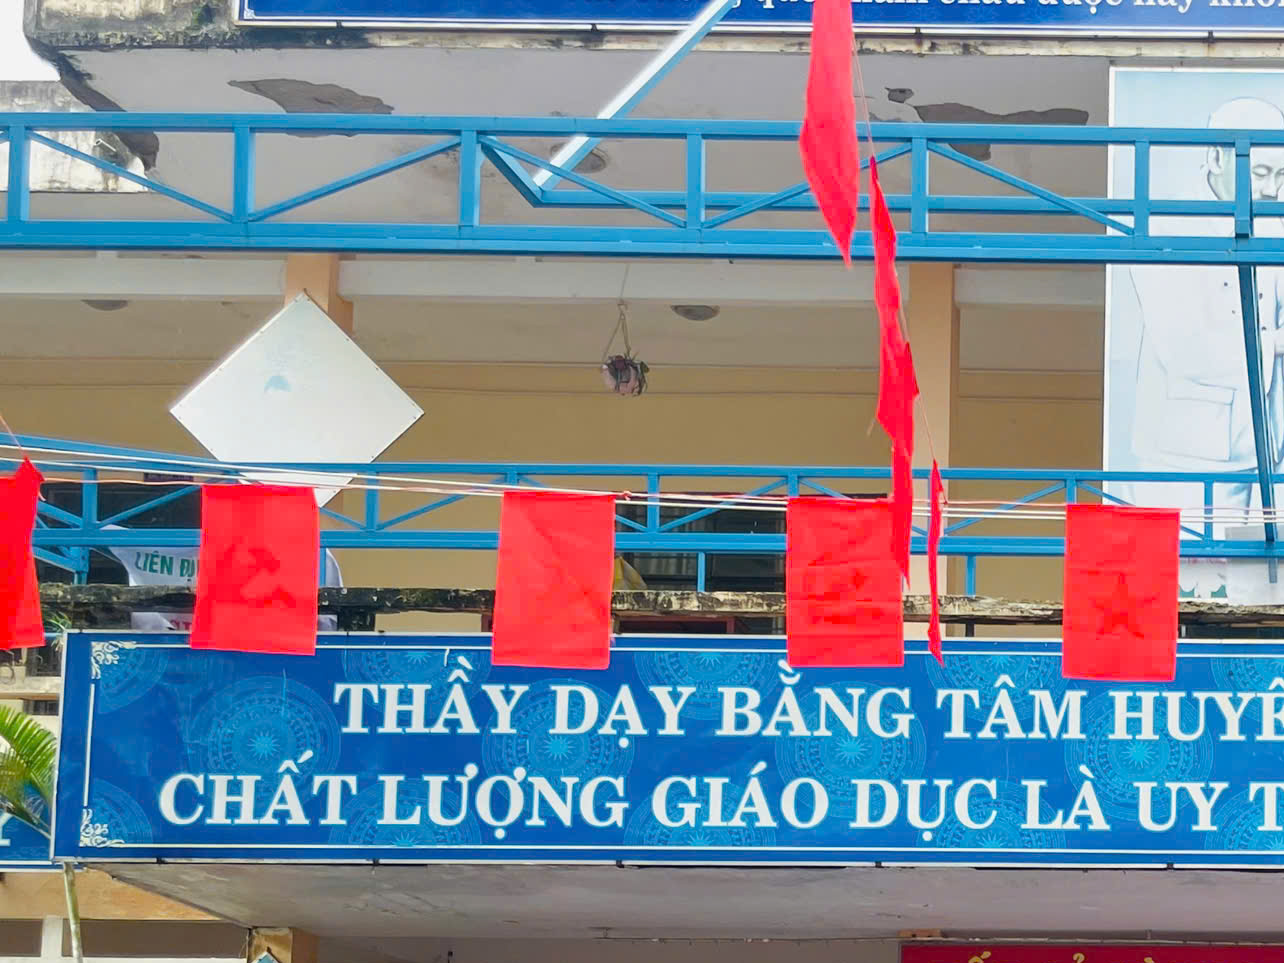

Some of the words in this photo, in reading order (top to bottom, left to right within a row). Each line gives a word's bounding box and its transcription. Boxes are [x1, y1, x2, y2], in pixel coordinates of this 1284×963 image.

[179, 557, 199, 582] ĐỊ
[334, 655, 530, 735] THẦY
[549, 685, 696, 748] DẠY
[715, 659, 915, 739] BẰNG
[937, 674, 1087, 741] TÂM
[158, 750, 358, 826] CHẤT
[378, 763, 627, 839] LƯỢNG
[652, 761, 830, 829] GIÁO
[850, 777, 999, 842] DỤC
[1021, 764, 1110, 831] LÀ
[1133, 780, 1229, 832] UY
